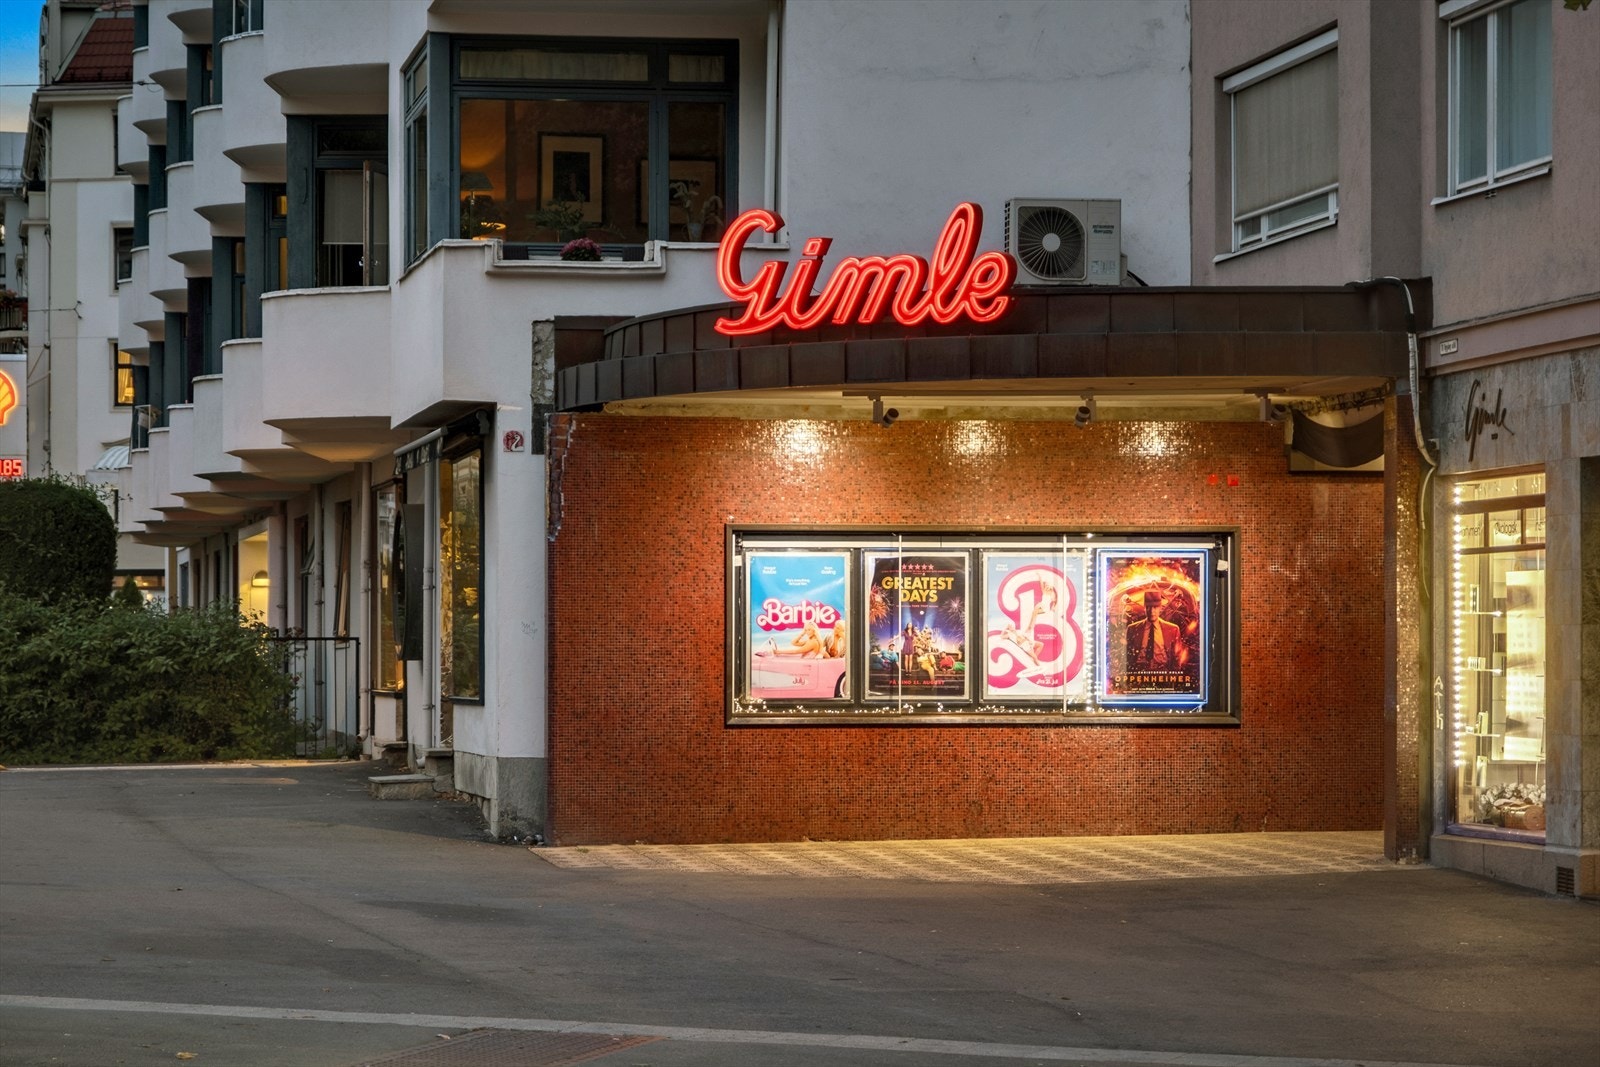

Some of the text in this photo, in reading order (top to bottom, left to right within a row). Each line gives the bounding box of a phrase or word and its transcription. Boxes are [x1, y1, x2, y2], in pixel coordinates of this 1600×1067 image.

[712, 202, 1017, 337] Gimle
[1464, 378, 1515, 462] Gimle
[881, 576, 954, 590] GREATEST
[900, 589, 939, 603] DAYS
[756, 598, 839, 628] Barbie
[1114, 675, 1191, 683] OPPENHEIMER
